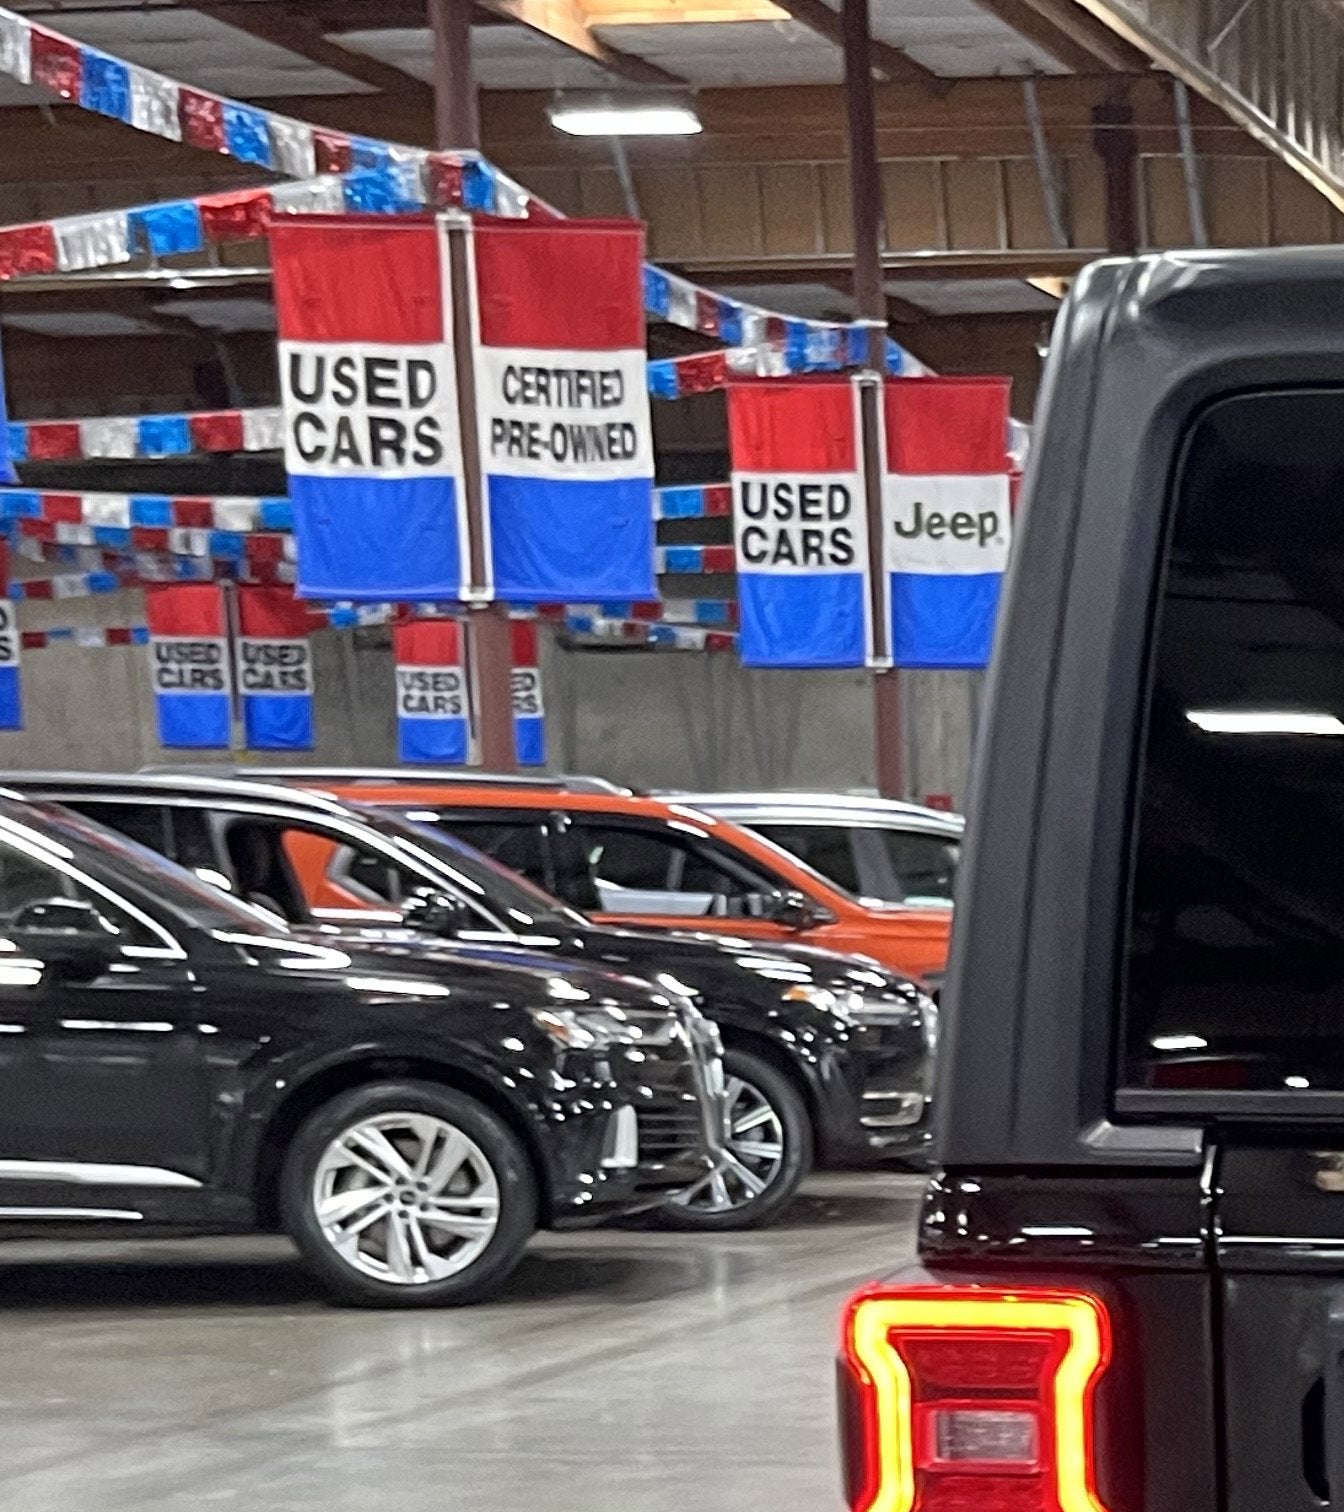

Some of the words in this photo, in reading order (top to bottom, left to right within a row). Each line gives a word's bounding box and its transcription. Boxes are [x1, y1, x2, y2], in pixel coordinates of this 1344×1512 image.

[290, 352, 436, 407] USED
[502, 365, 624, 408] CERTIFIED
[293, 411, 443, 466] CARS
[491, 417, 637, 463] PRE-OWNED
[741, 481, 851, 521] USED
[741, 526, 855, 565] CARS
[894, 502, 999, 547] Jeep
[400, 672, 461, 692] USED
[402, 694, 462, 714] CARS
